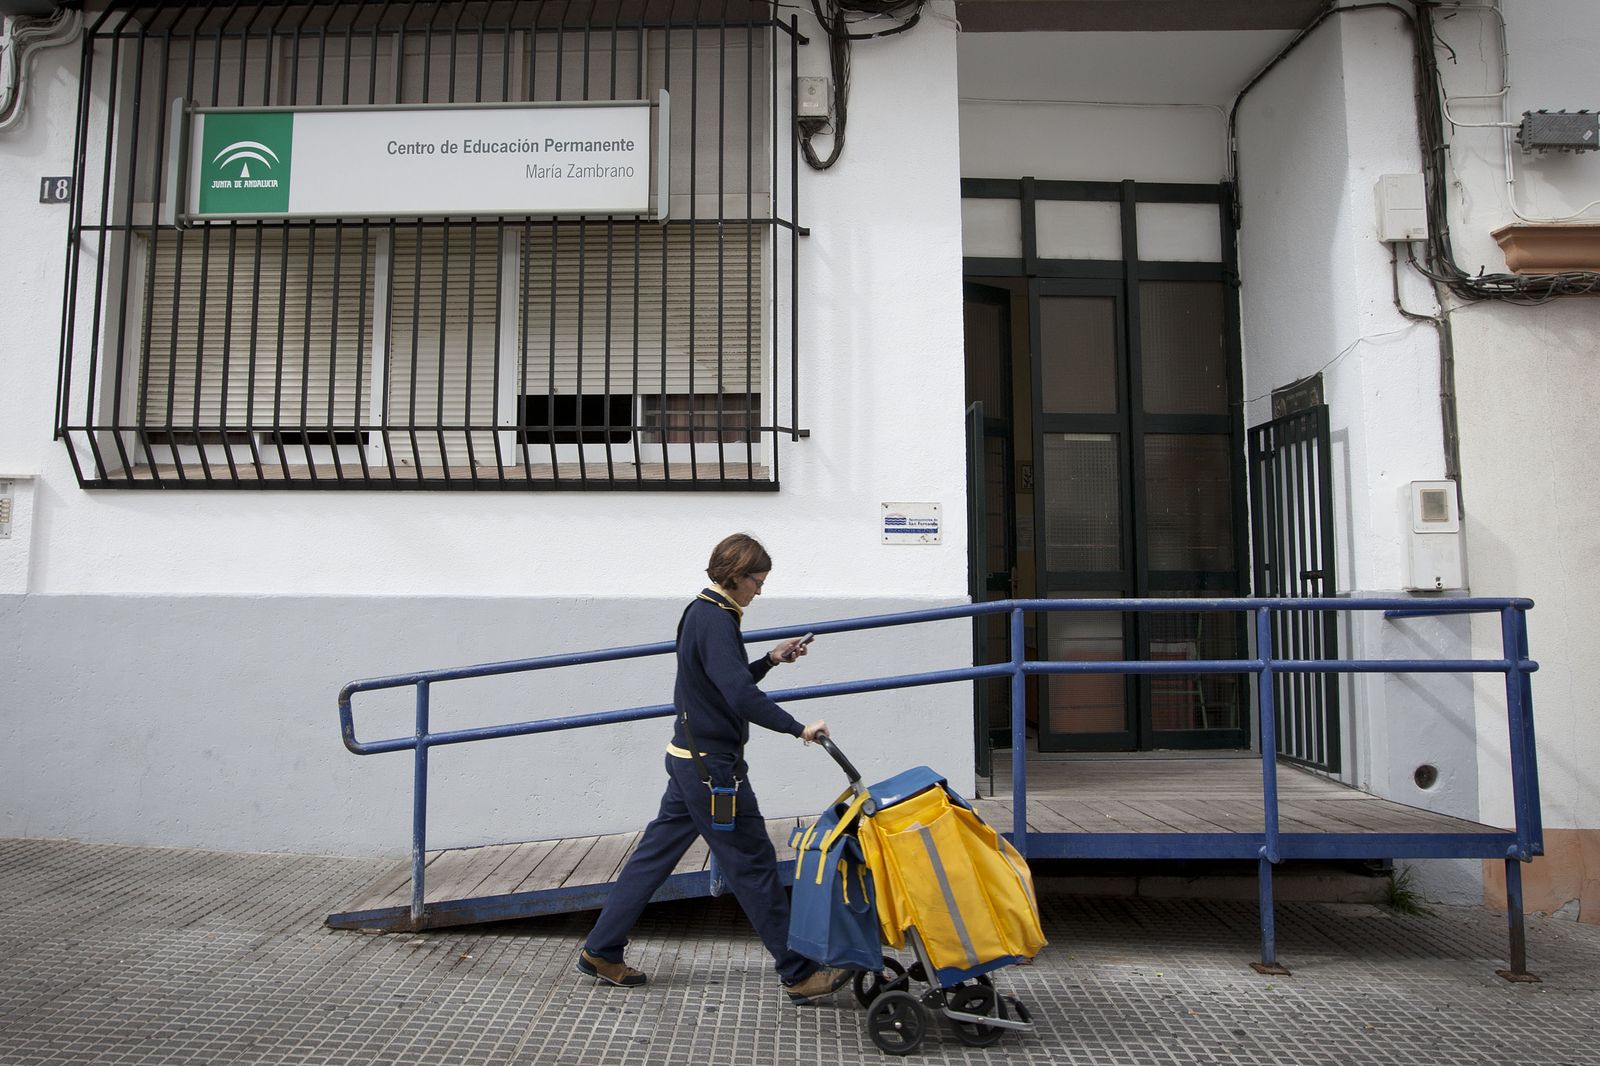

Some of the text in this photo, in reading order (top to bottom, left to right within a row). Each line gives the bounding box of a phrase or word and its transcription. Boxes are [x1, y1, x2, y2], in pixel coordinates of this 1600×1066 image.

[387, 137, 635, 155] Centro de Educación Permanente
[526, 162, 634, 179] María Zambrano
[43, 179, 68, 200] 18
[211, 180, 232, 189] JUNTA
[234, 180, 243, 189] DE
